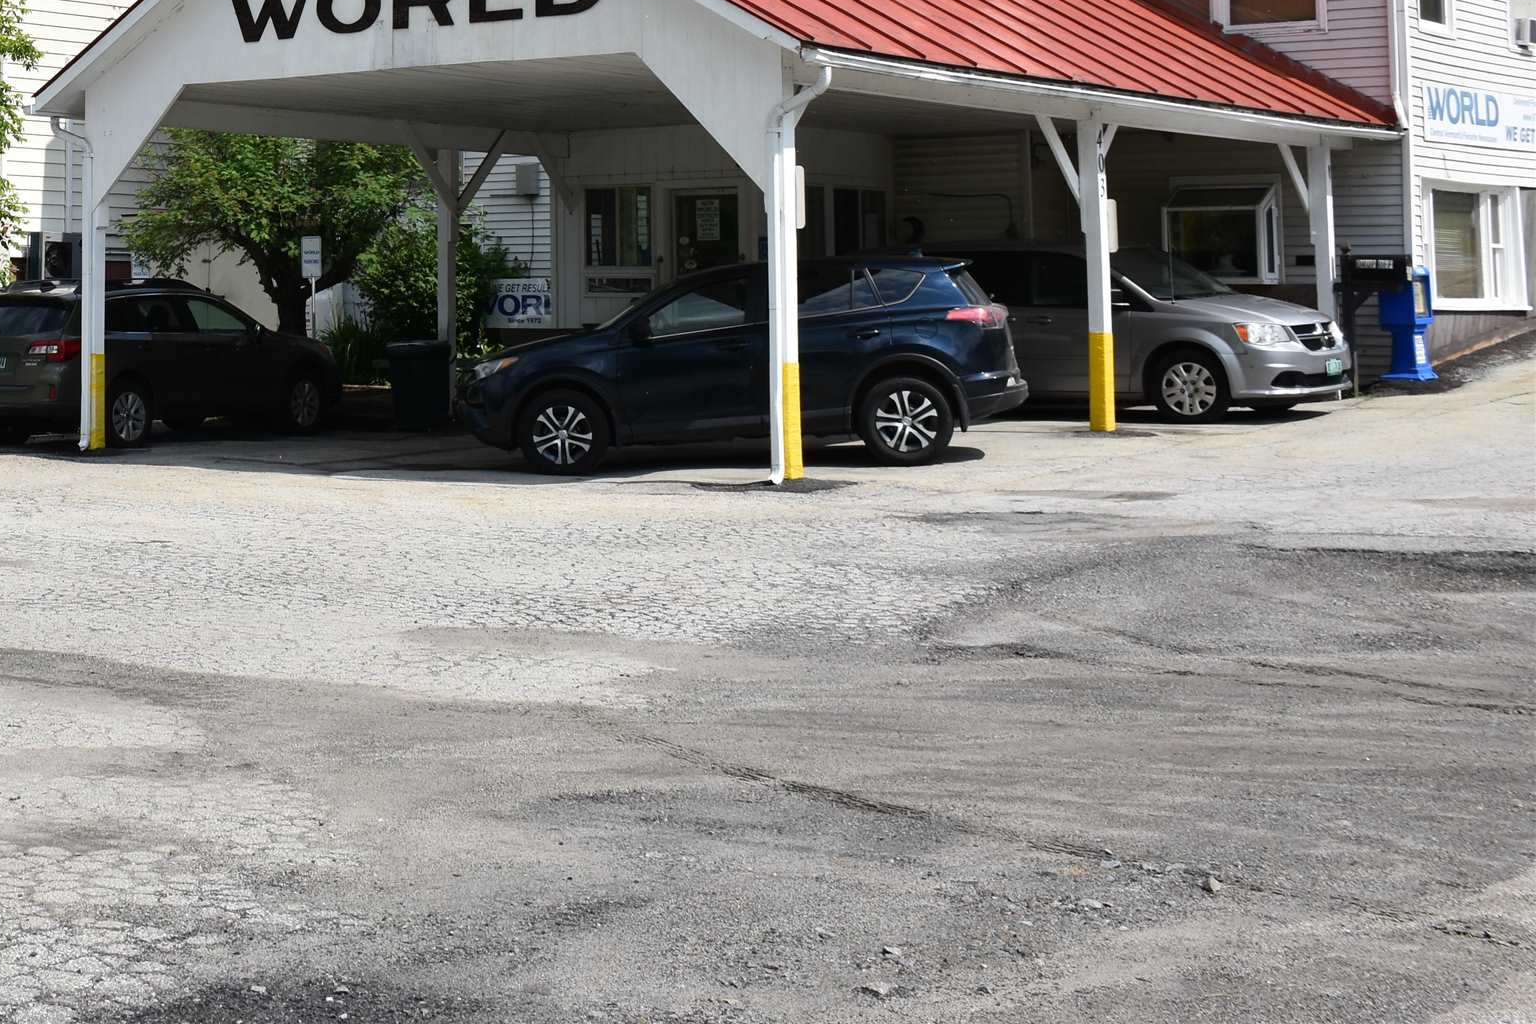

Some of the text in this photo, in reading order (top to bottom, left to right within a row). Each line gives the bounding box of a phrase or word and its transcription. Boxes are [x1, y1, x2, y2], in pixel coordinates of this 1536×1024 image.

[1427, 86, 1499, 127] WORLD
[1096, 129, 1105, 198] 403
[505, 283, 520, 293] GET
[521, 283, 551, 293] RESUL
